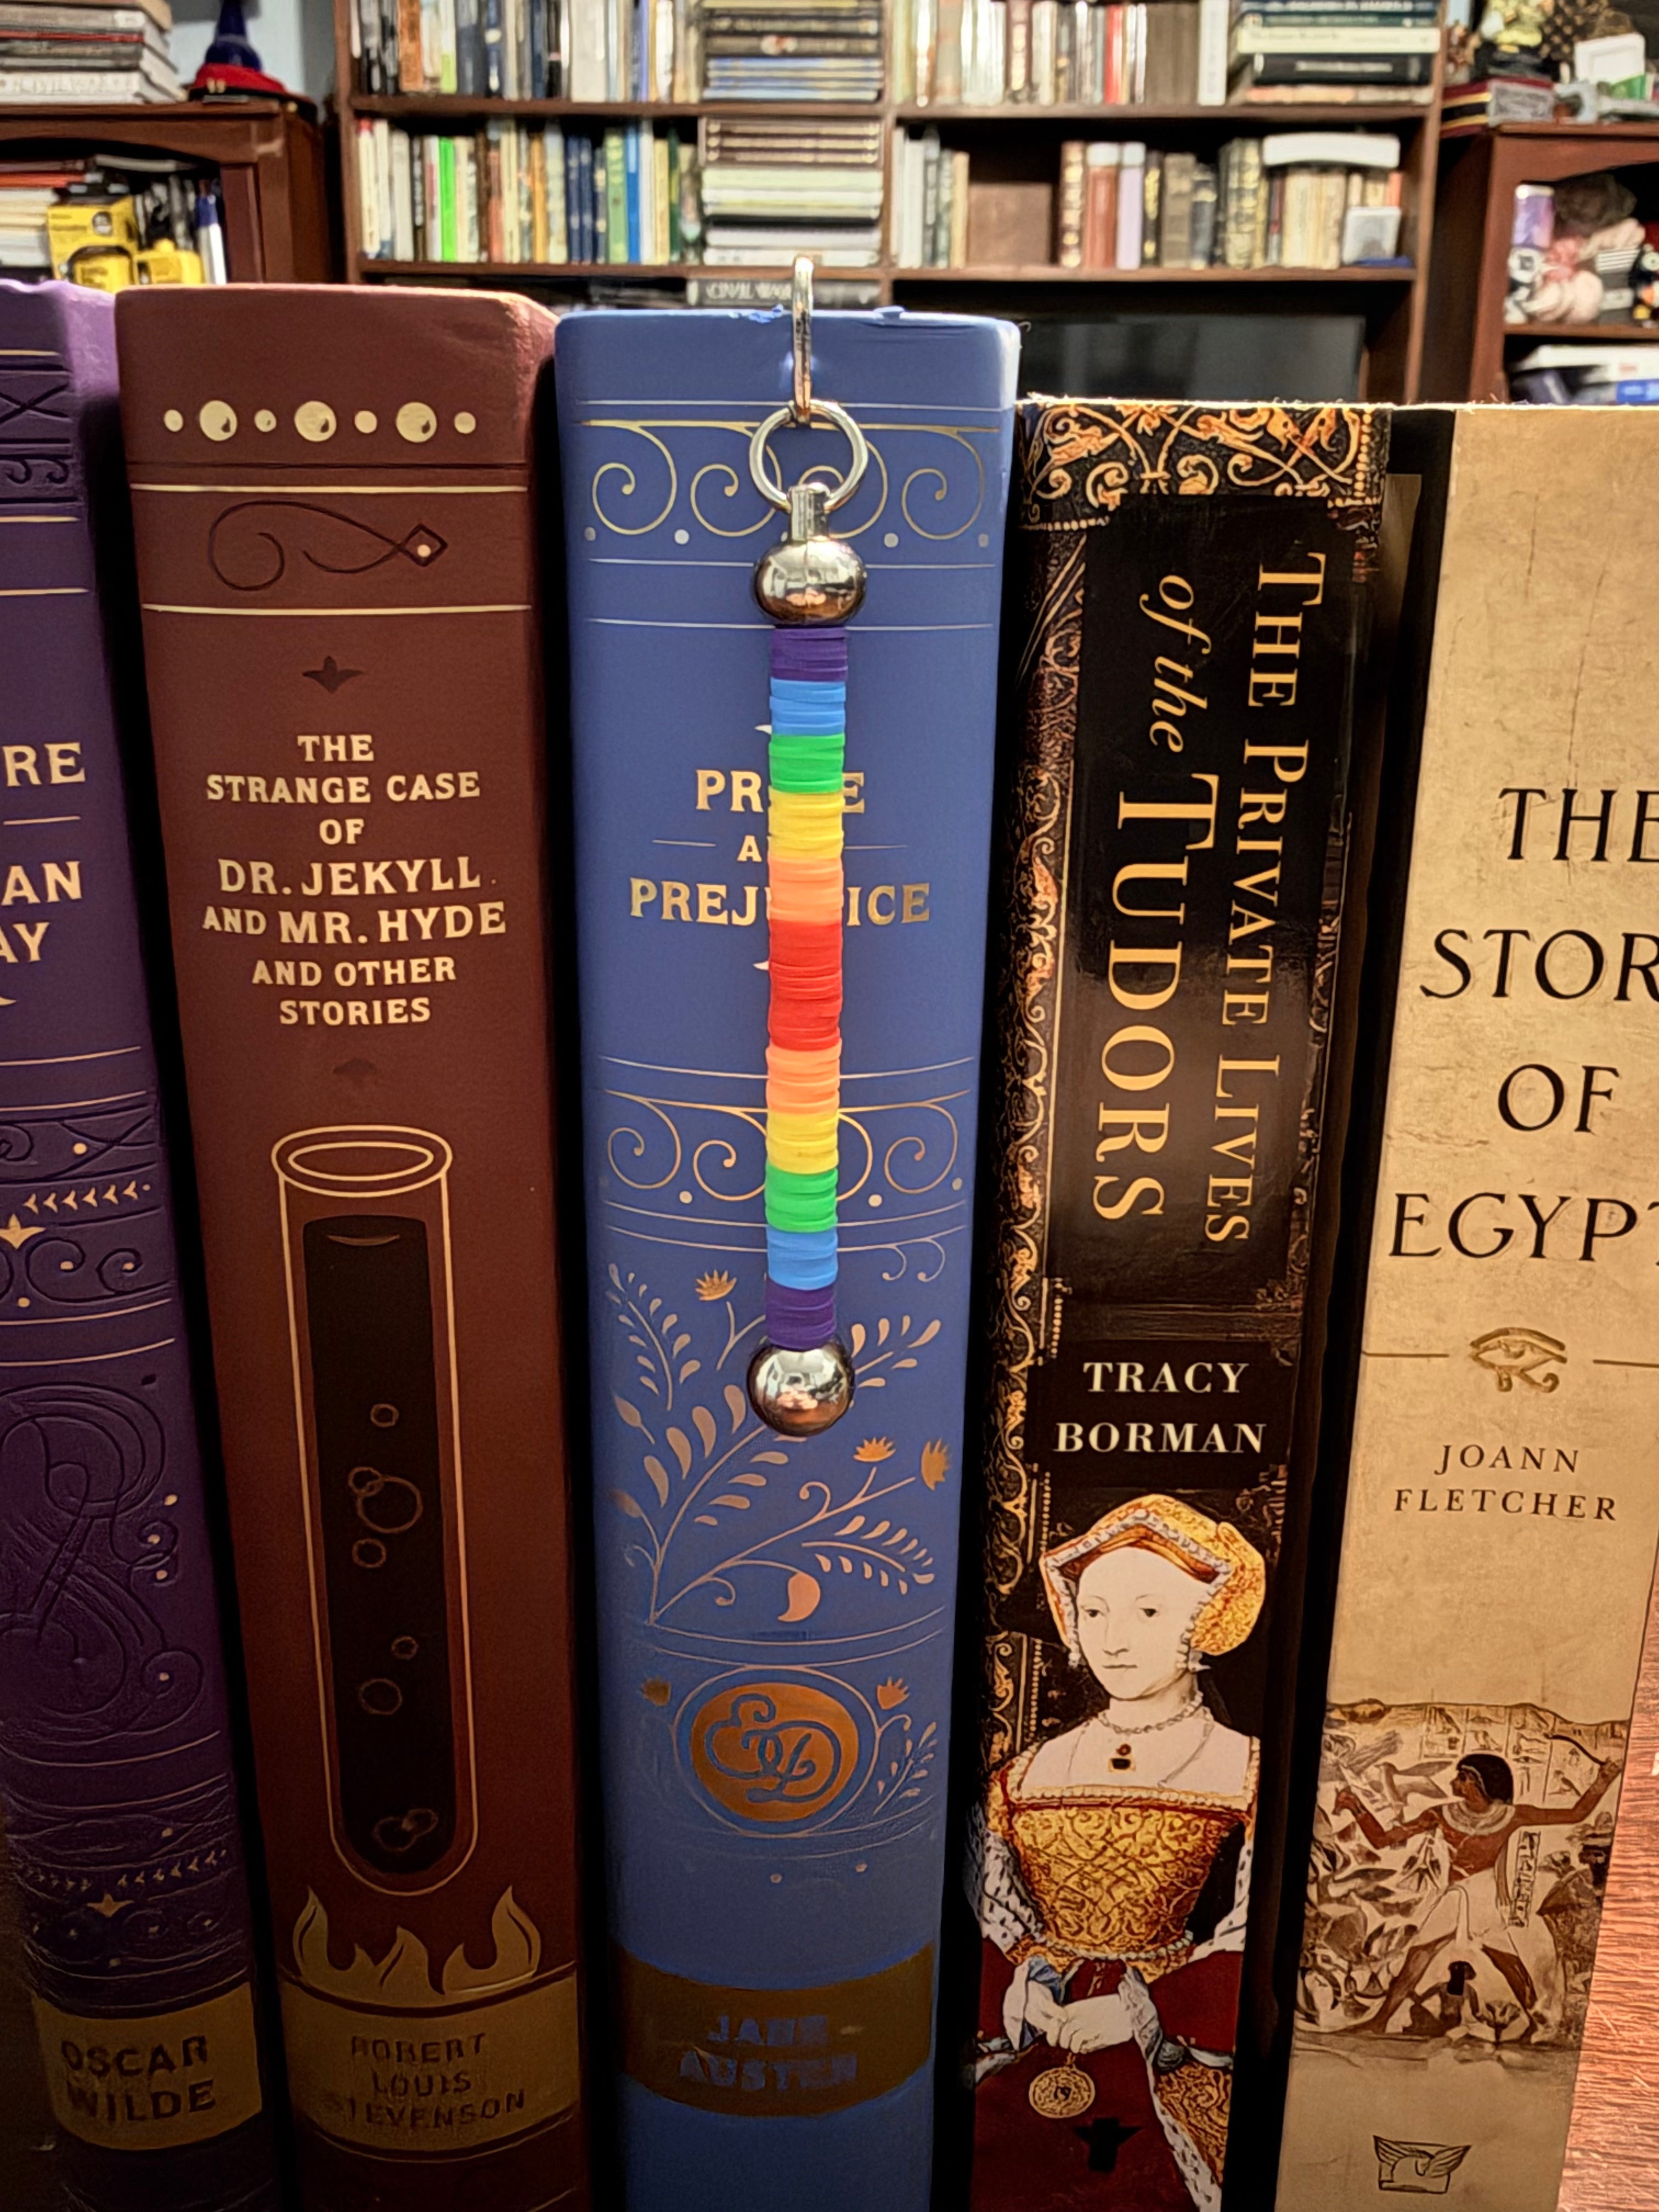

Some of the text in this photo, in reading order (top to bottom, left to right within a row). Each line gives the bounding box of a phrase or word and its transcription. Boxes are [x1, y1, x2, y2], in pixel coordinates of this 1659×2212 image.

[2, 742, 86, 787] RE
[297, 734, 375, 762] THE
[207, 771, 481, 804] STRANGE CASE
[696, 769, 865, 814] PRE
[319, 819, 365, 845] OF
[1498, 788, 1659, 863] THE
[1, 861, 82, 906] AN
[218, 856, 481, 896] DR. JEKYLL
[629, 877, 930, 926] PREJICE
[1092, 574, 1221, 1221] of the TUDORS
[1204, 552, 1327, 1242] THE PRIVATE LIVES
[202, 901, 506, 944] AND MR. HYDE
[252, 956, 457, 987] AND OTHER
[280, 997, 431, 1026] STORIES
[1497, 1063, 1620, 1133] OF
[1389, 1191, 1659, 1267] EGYP
[1082, 1362, 1250, 1393] TRACY
[1052, 1423, 1267, 1453] BORMAN
[1433, 1444, 1579, 1476] JOANN
[1394, 1488, 1617, 1521] FLETCHER
[61, 2036, 208, 2077] OSCAR
